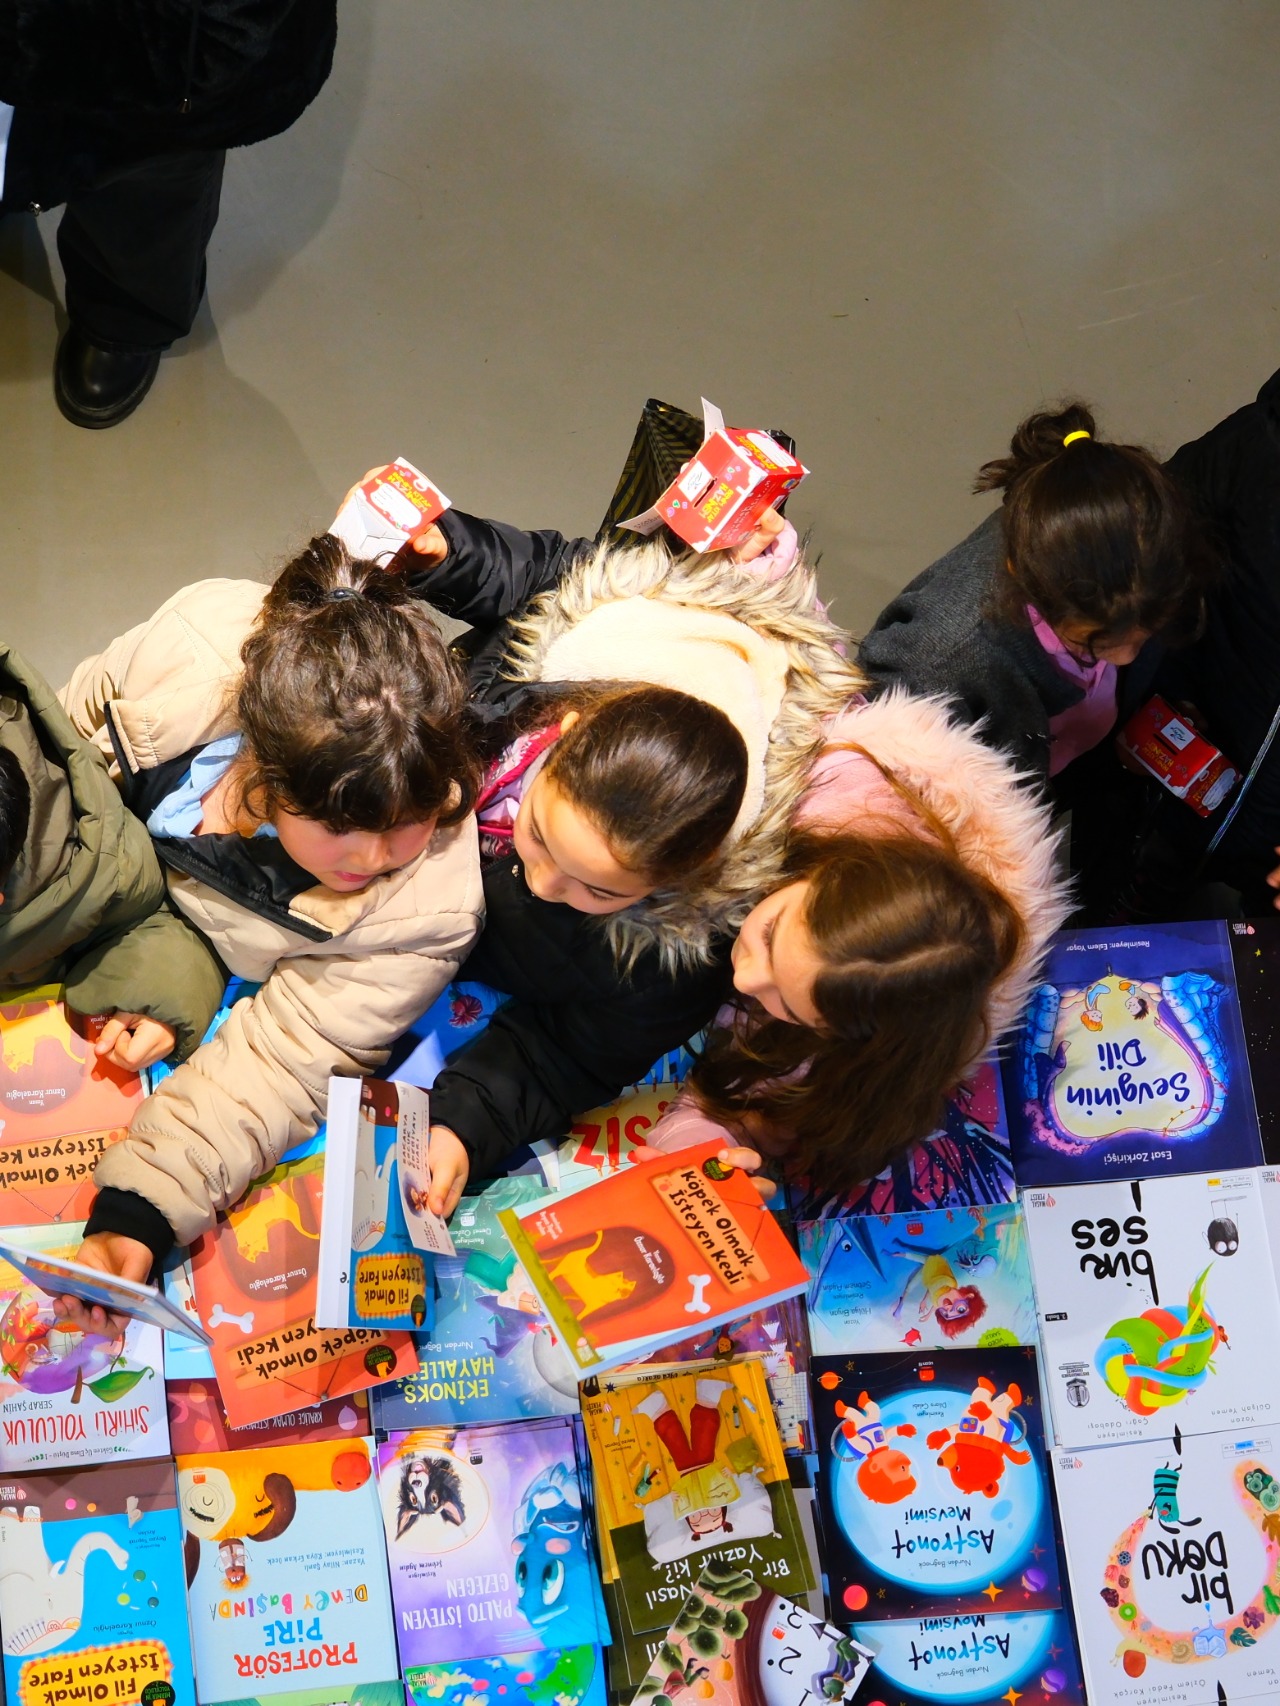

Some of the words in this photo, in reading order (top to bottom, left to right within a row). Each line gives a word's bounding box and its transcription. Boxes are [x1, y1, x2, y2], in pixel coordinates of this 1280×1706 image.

[1065, 942, 1087, 952] Yaşar
[1087, 943, 1108, 951] Eslem
[1109, 939, 1150, 950] Resimleyen:
[1097, 1037, 1148, 1072] Dili
[1066, 1068, 1191, 1117] Sevginin
[28, 1134, 106, 1162] İsteyen
[1103, 1151, 1149, 1166] Zorkirişçi
[1150, 1150, 1172, 1162] Esat
[680, 1170, 723, 1216] Köpek
[716, 1217, 755, 1267] Olmak
[668, 1189, 716, 1250] İsteyen
[710, 1251, 745, 1286] Kedi
[1070, 1215, 1149, 1251] ses
[358, 1269, 380, 1286] Fare
[1080, 1249, 1159, 1307] bir
[364, 1288, 396, 1307] Olmak
[398, 1287, 410, 1305] Fil
[237, 1336, 279, 1364] Kedi
[320, 1329, 382, 1357] Köpek
[445, 1340, 474, 1351] Nurdan
[255, 1347, 317, 1380] Olmak
[403, 1378, 490, 1405] EKİNOKS
[2, 1400, 27, 1414] ŞAHİN
[28, 1400, 53, 1411] SERAP
[1210, 1407, 1238, 1418] Yemen
[1240, 1402, 1272, 1415] Gülşah
[2, 1413, 88, 1447] YOLCULUK
[93, 1405, 149, 1439] SİHİRLİ
[1124, 1417, 1149, 1430] Çağrı
[1229, 1416, 1256, 1426] Yazan
[1096, 1429, 1143, 1441] Resimleyen
[904, 1506, 972, 1526] Mevsimi
[891, 1526, 995, 1559] Astronot
[1141, 1530, 1228, 1581] DOKU
[665, 1555, 691, 1584] ki?
[762, 1558, 791, 1580] Bir
[446, 1572, 510, 1599] GEZEGEN
[645, 1581, 696, 1610] Nasıl
[1181, 1571, 1235, 1616] bir
[402, 1604, 463, 1631] İSTEYEN
[467, 1599, 513, 1623] PALTO
[262, 1617, 324, 1647] PİRE
[918, 1614, 986, 1636] Mevsimi
[233, 1641, 358, 1679] PROFESÖR
[908, 1632, 1011, 1671] Astronot
[28, 1665, 74, 1689] Fare
[78, 1652, 160, 1678] İsteyen
[1246, 1667, 1274, 1679] Yemen
[42, 1681, 108, 1706] Olmak
[114, 1677, 136, 1695] Fil
[1113, 1685, 1146, 1699] Korçak
[1147, 1682, 1173, 1694] Fedai
[1176, 1678, 1206, 1690] Özlem
